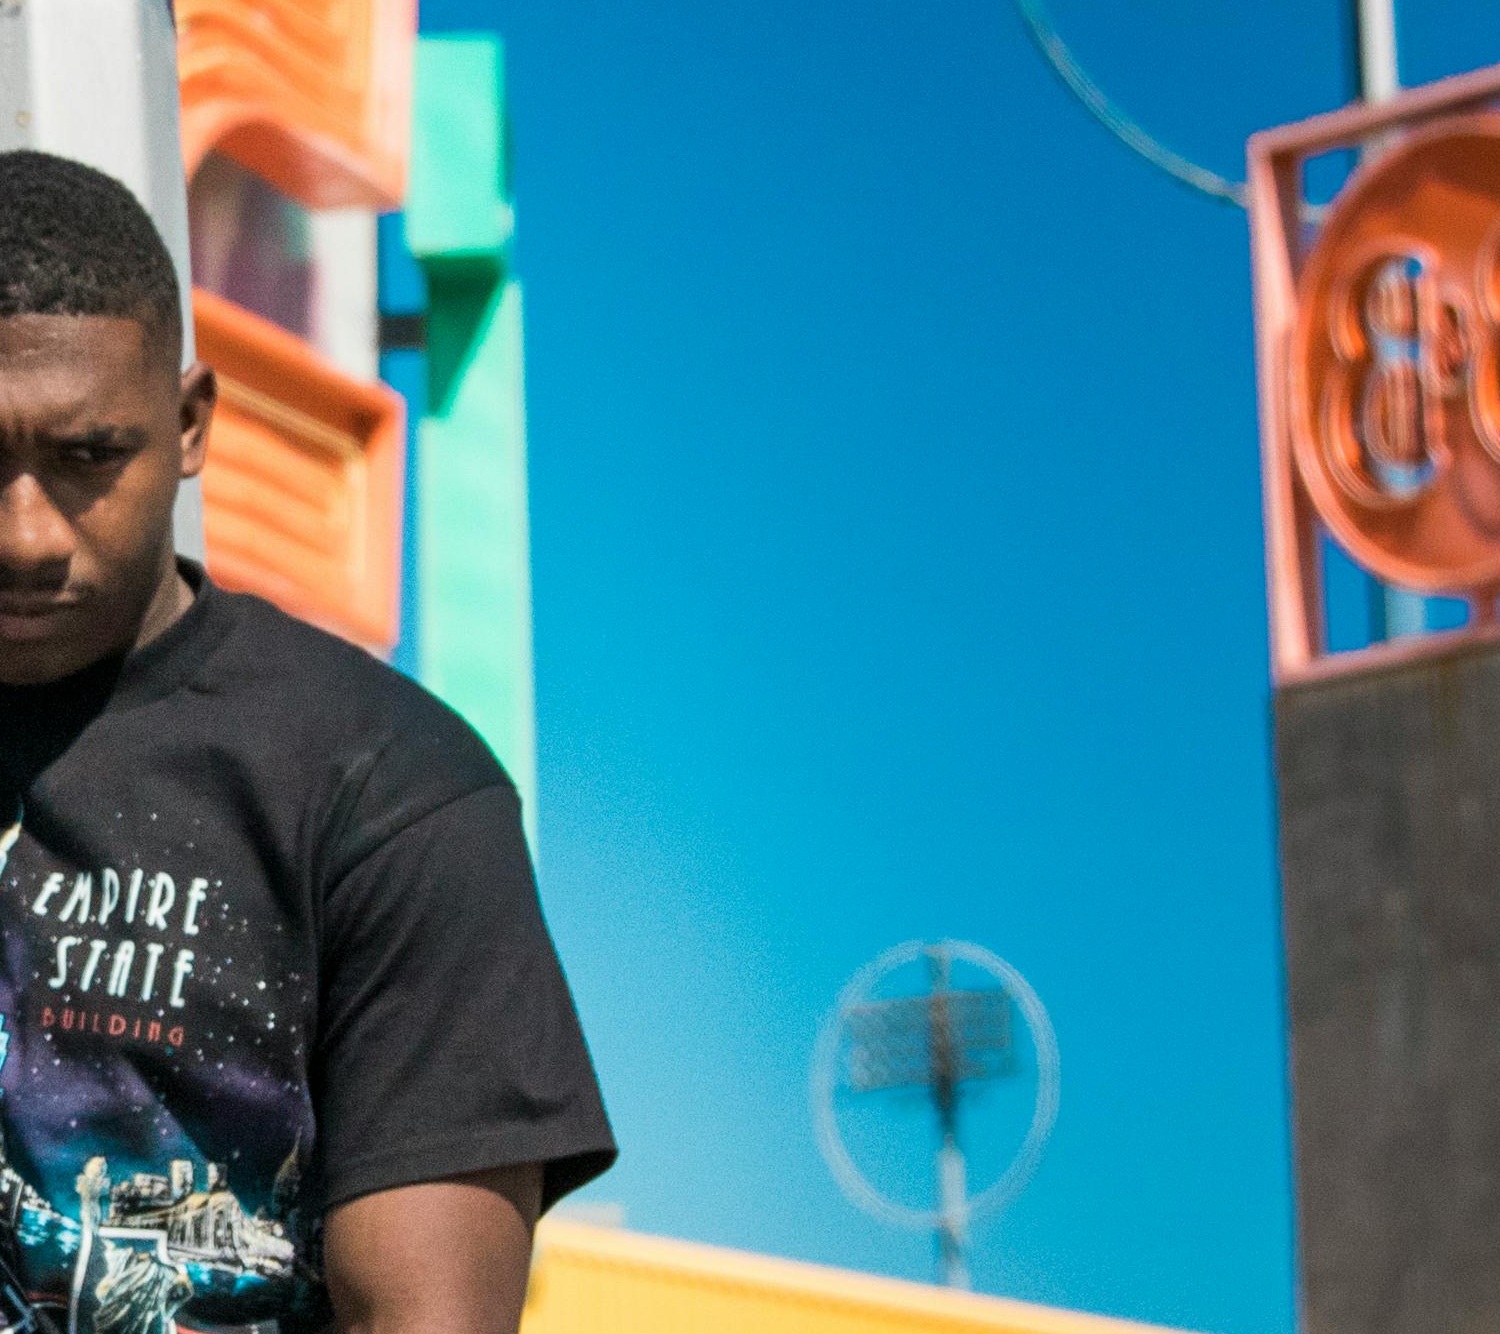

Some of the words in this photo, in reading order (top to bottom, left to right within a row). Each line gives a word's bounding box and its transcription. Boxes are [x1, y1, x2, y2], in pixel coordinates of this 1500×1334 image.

[32, 867, 209, 935] EMPIRE
[48, 935, 196, 1008] STATE
[41, 1006, 185, 1048] BUILDING
